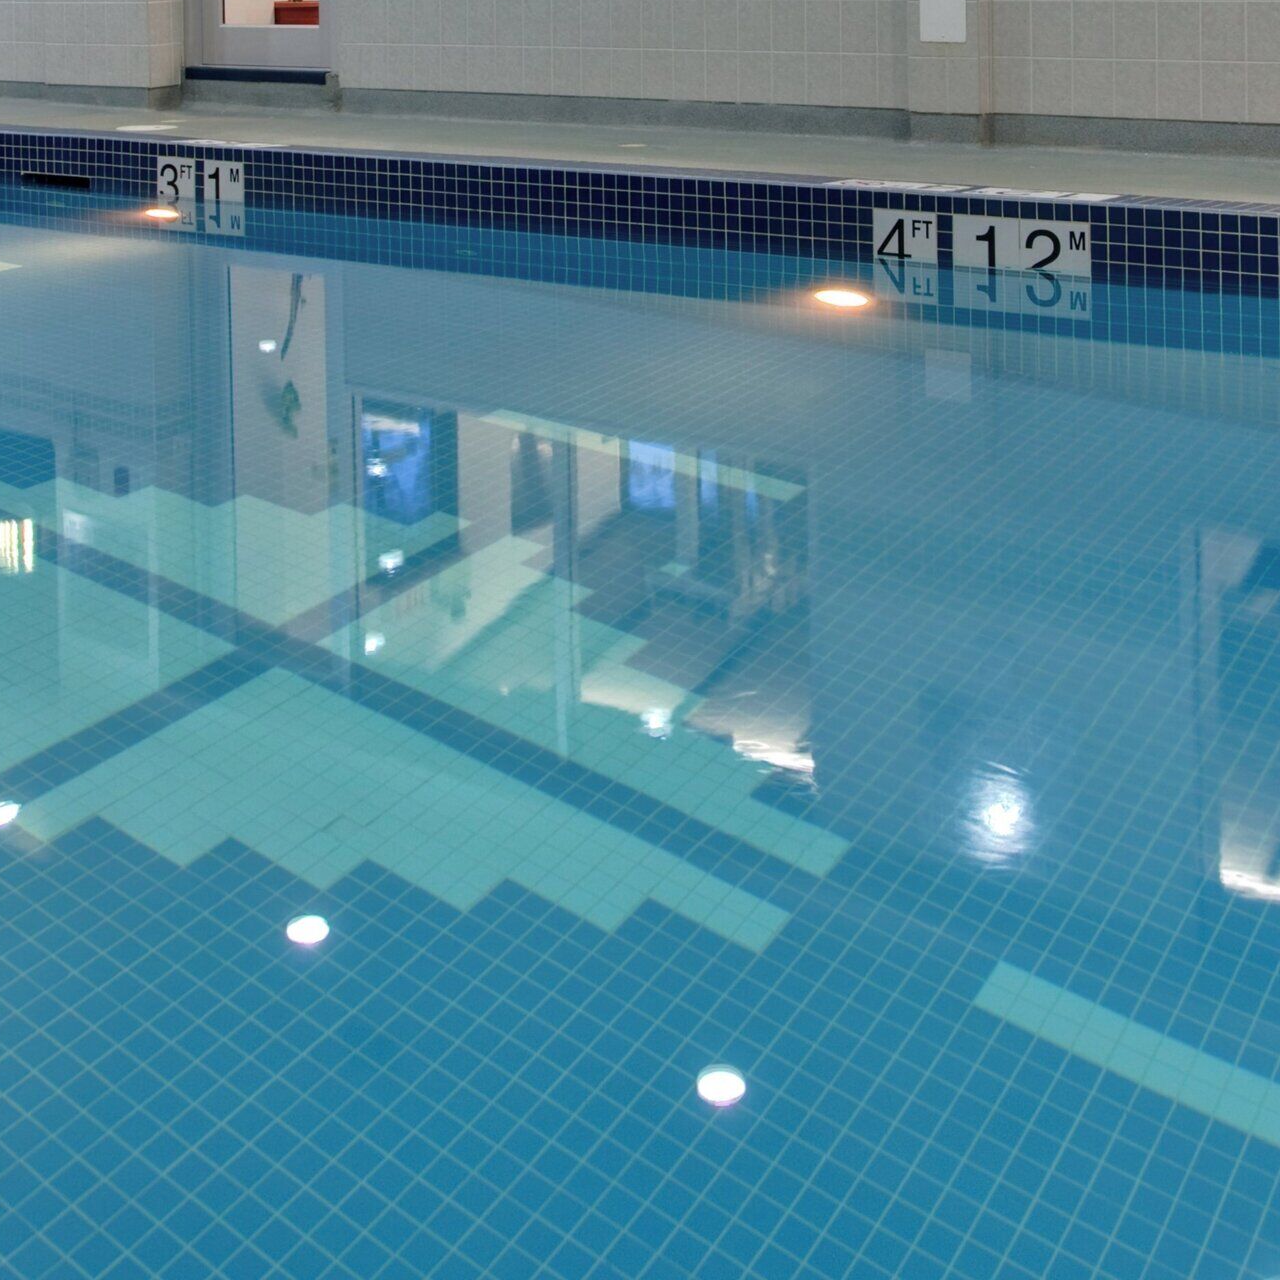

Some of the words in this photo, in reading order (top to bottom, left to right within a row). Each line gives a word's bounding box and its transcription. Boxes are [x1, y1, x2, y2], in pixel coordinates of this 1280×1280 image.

[160, 164, 179, 196] 3
[180, 164, 193, 180] FT
[230, 168, 240, 183] M
[877, 218, 912, 259] 4
[912, 220, 932, 239] FT
[1069, 231, 1086, 251] M
